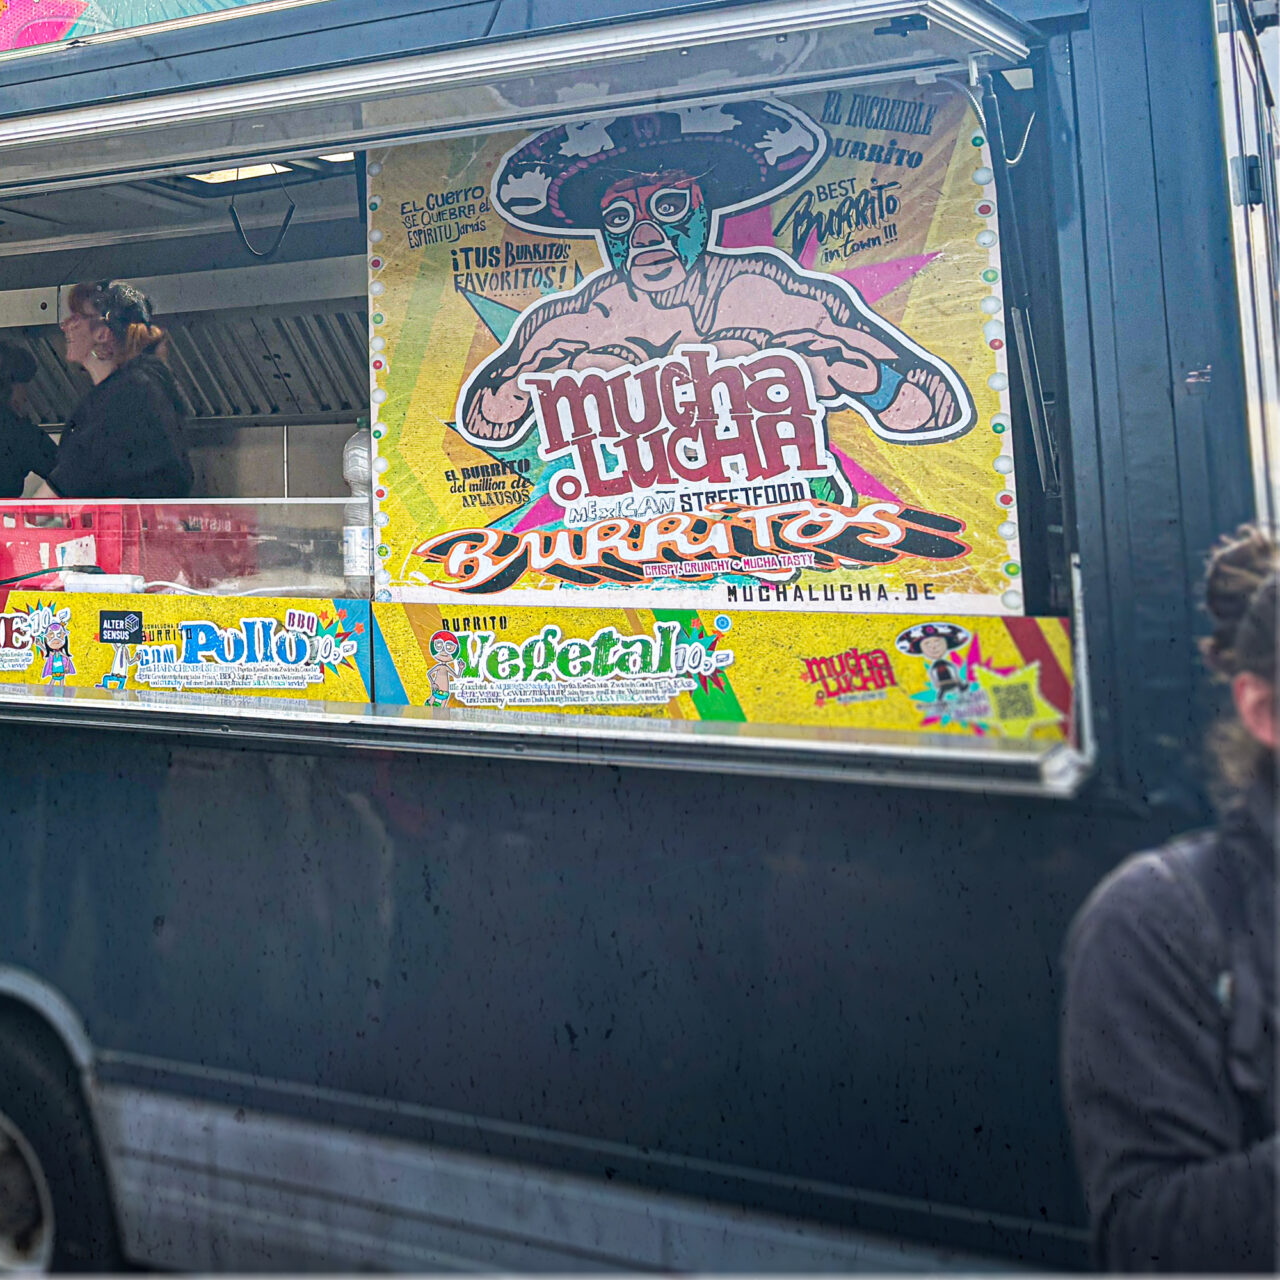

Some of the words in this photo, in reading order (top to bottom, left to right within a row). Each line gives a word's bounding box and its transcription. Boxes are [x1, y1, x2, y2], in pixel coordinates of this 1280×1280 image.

[821, 91, 842, 125] EL
[833, 138, 923, 169] URRITO
[816, 178, 857, 202] BEST
[401, 200, 424, 215] EL
[402, 214, 419, 229] SE
[479, 196, 491, 213] el
[451, 246, 500, 272] ¡TUS
[822, 247, 840, 263] in
[444, 469, 460, 481] EL
[461, 458, 530, 480] BURRITO
[450, 480, 466, 493] del
[469, 478, 506, 492] million
[511, 477, 530, 489] de
[462, 489, 530, 508] APLAUSOS
[680, 481, 807, 513] STREETFOOD
[684, 559, 731, 574] CRUNCHY
[743, 556, 778, 571] MUCHA
[780, 553, 815, 568] TASTY
[727, 582, 936, 603] MUCHALUCHA.DE
[103, 620, 125, 629] ALTER
[288, 612, 315, 633] BBQ
[442, 615, 508, 631] BURRITO
[103, 631, 130, 640] SENSUS
[183, 620, 307, 664] Pollo
[458, 622, 677, 681] Vegetal
